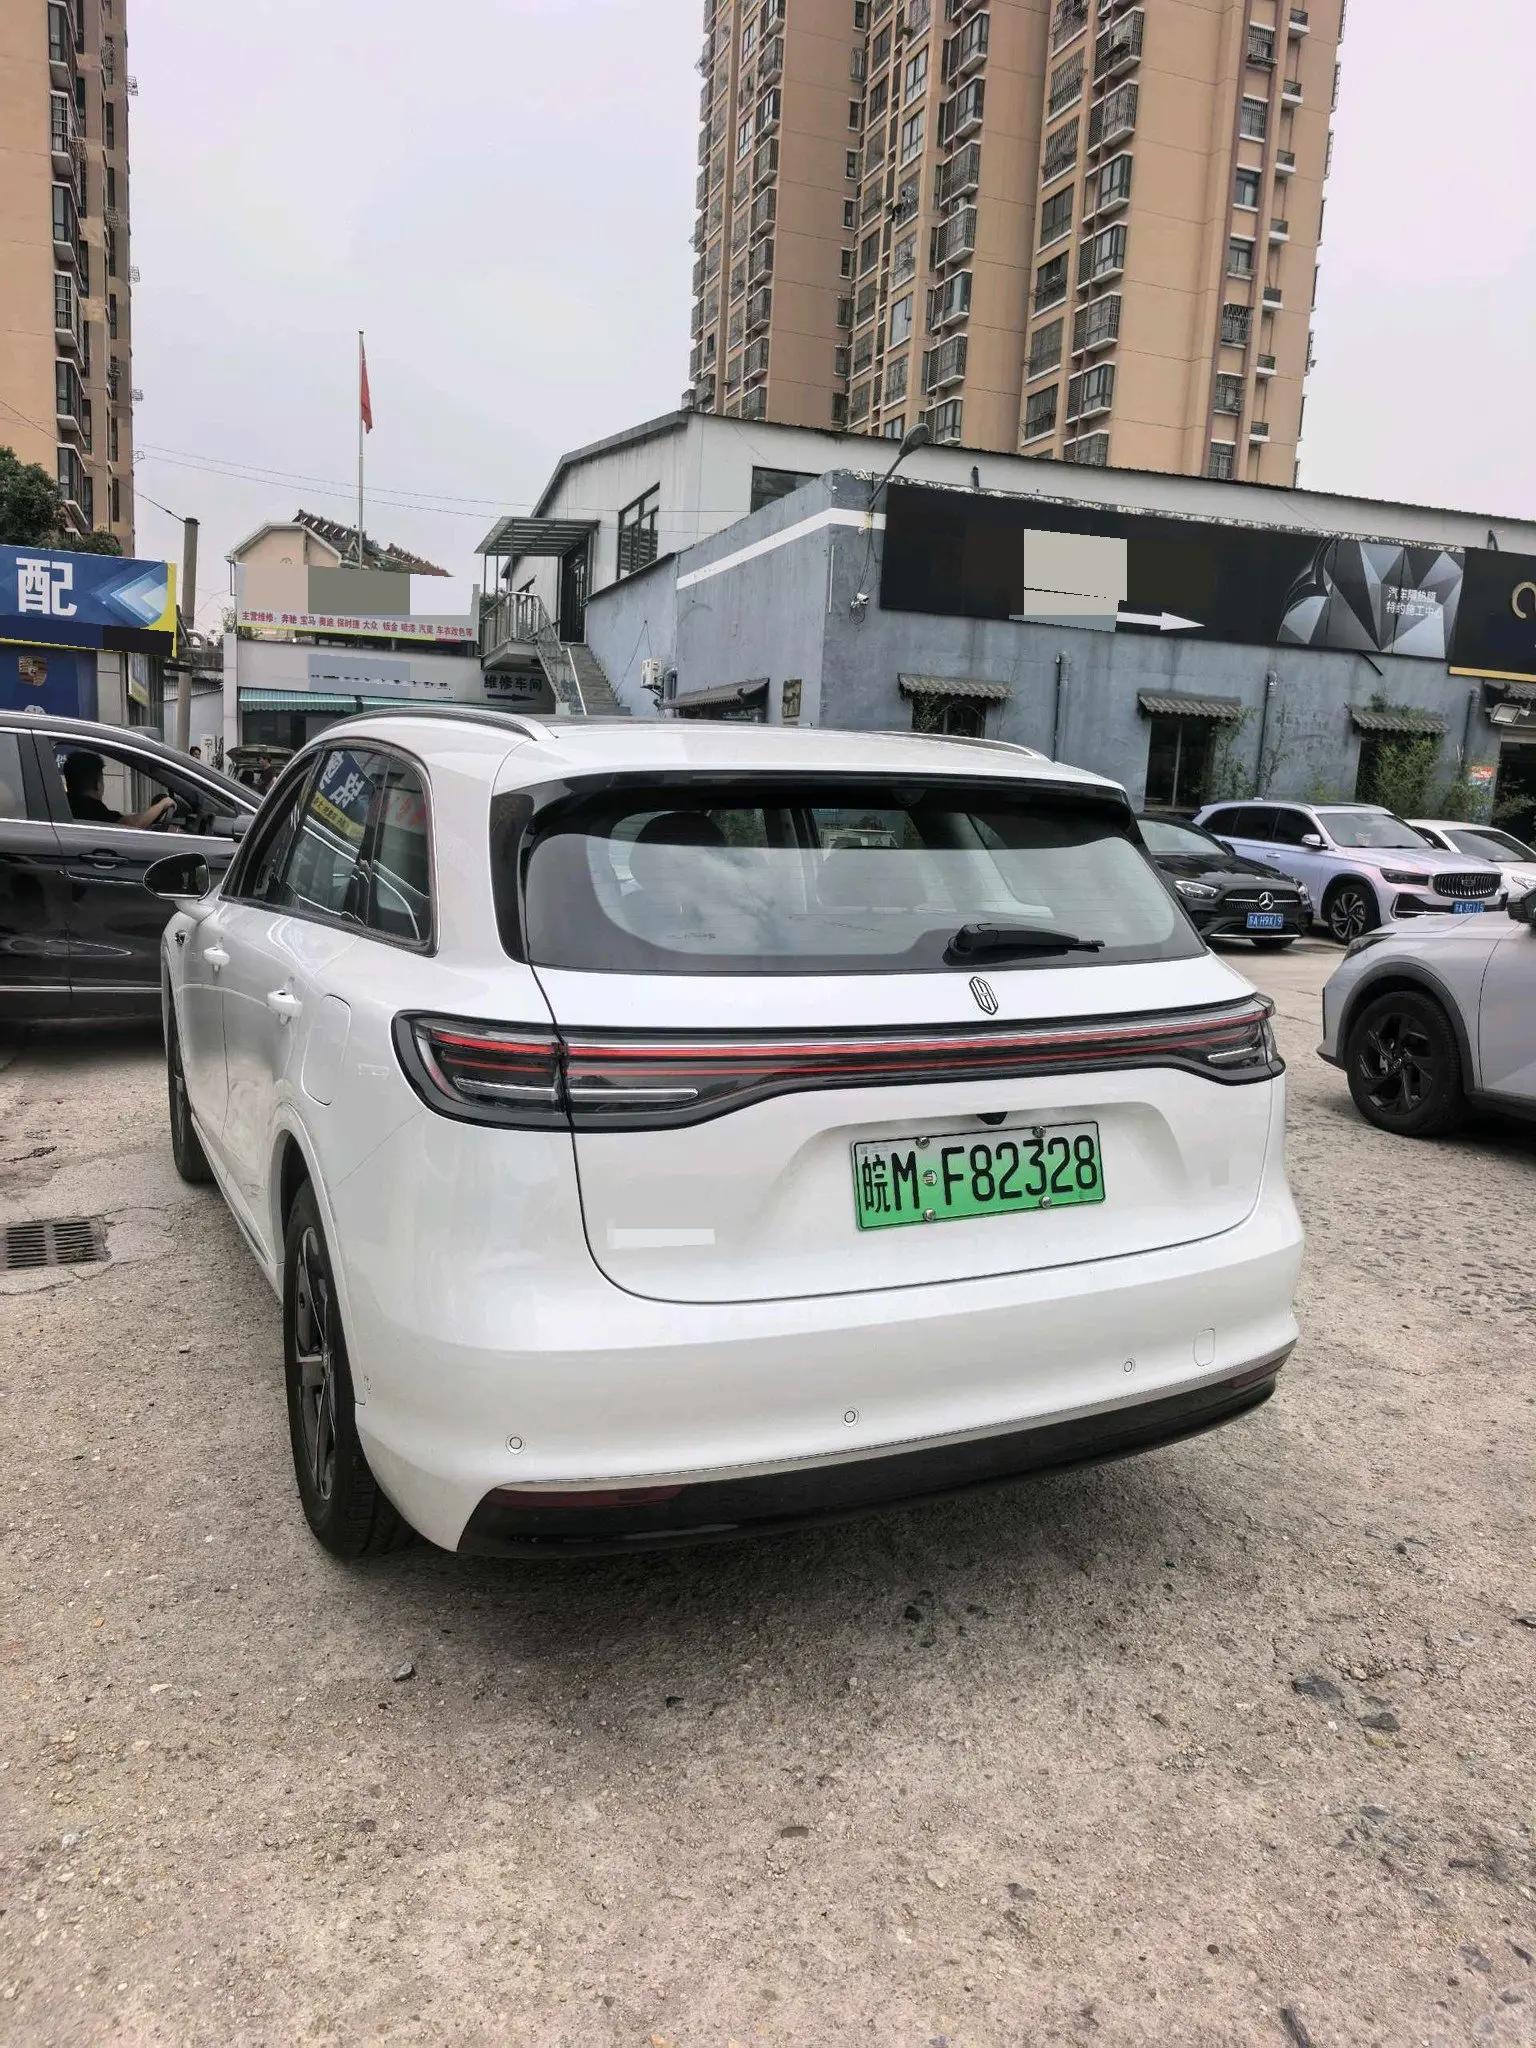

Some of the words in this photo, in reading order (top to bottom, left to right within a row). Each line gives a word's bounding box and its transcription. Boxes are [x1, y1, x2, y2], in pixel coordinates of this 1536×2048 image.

[16, 557, 77, 616] 配
[1385, 601, 1441, 617] 特约施工中心
[242, 611, 274, 622] 主营维修
[281, 613, 297, 624] 奔驰
[300, 615, 316, 625] 宝马
[337, 618, 360, 629] 保时捷
[363, 620, 379, 630] 大众
[382, 621, 398, 632] 钣金
[484, 674, 543, 692] 维修车间
